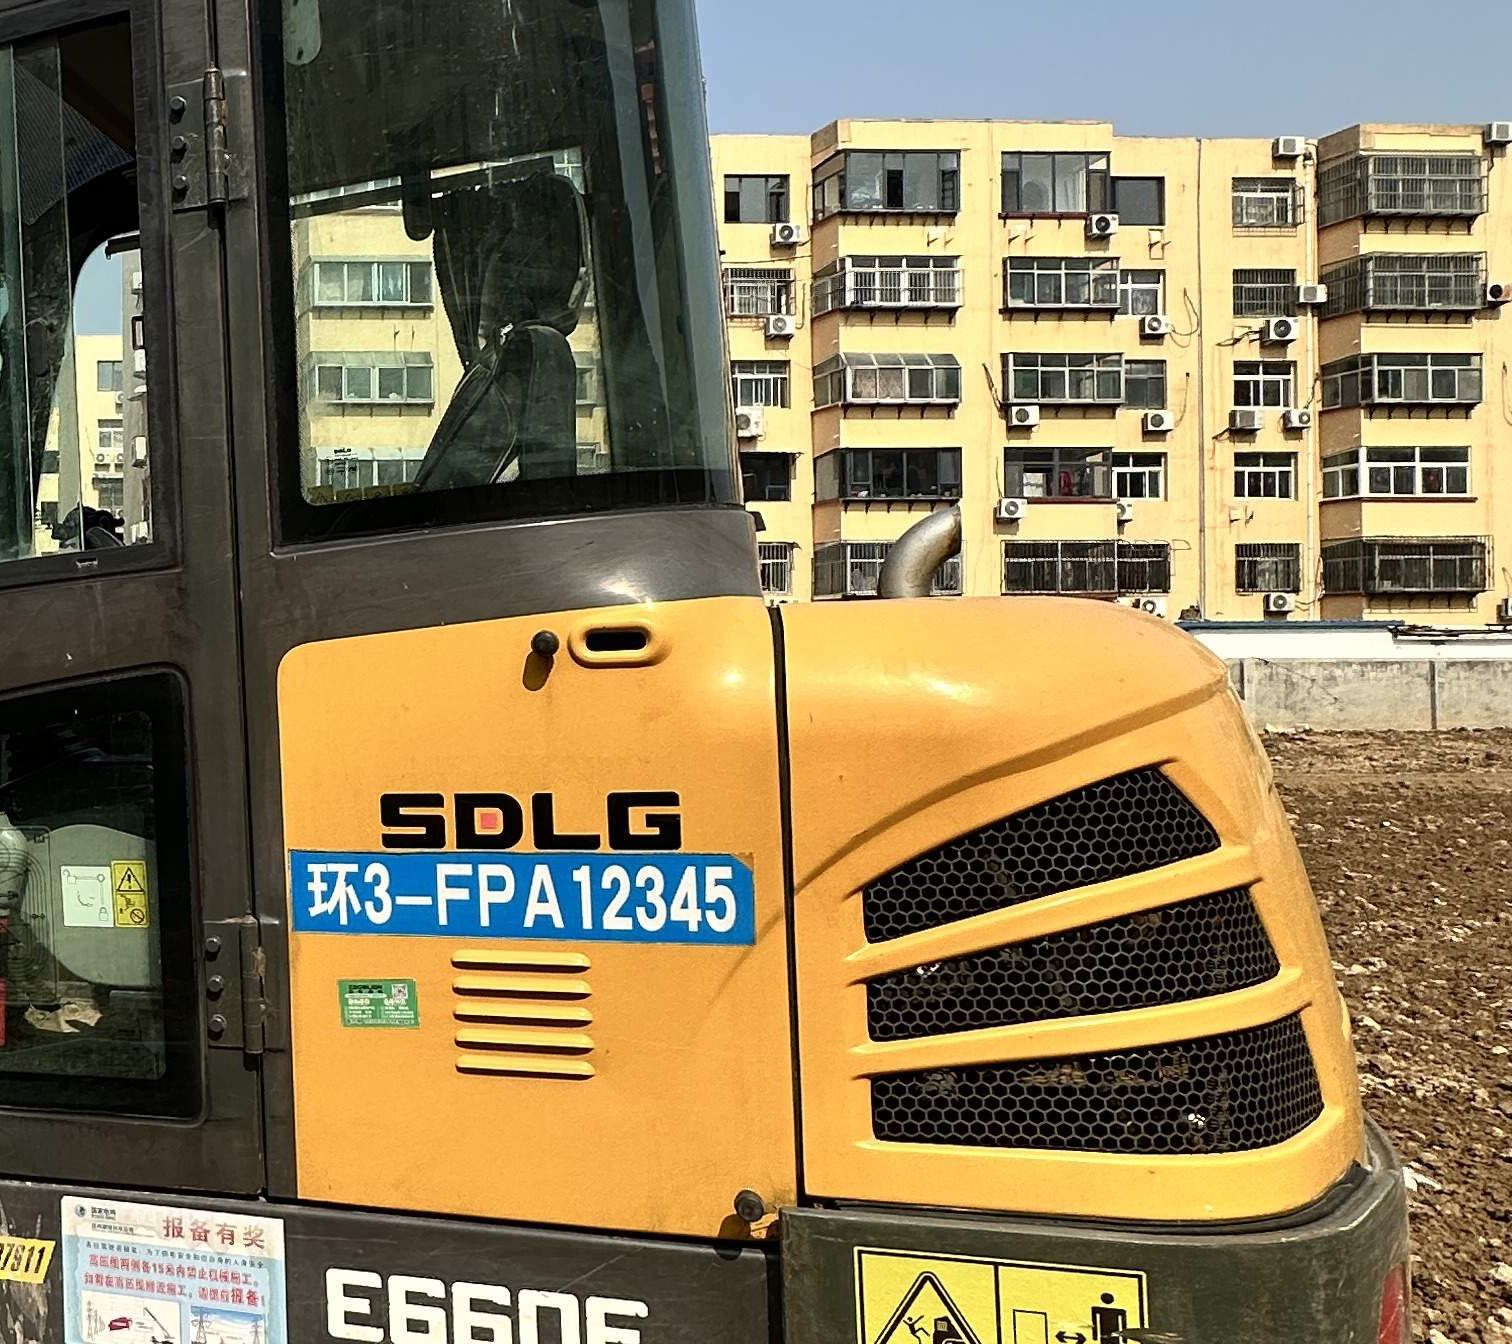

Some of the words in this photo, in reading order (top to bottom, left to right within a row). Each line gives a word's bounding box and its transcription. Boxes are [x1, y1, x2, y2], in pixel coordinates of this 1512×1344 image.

[379, 791, 682, 850] SDLG
[162, 1215, 265, 1250] 报备有奖
